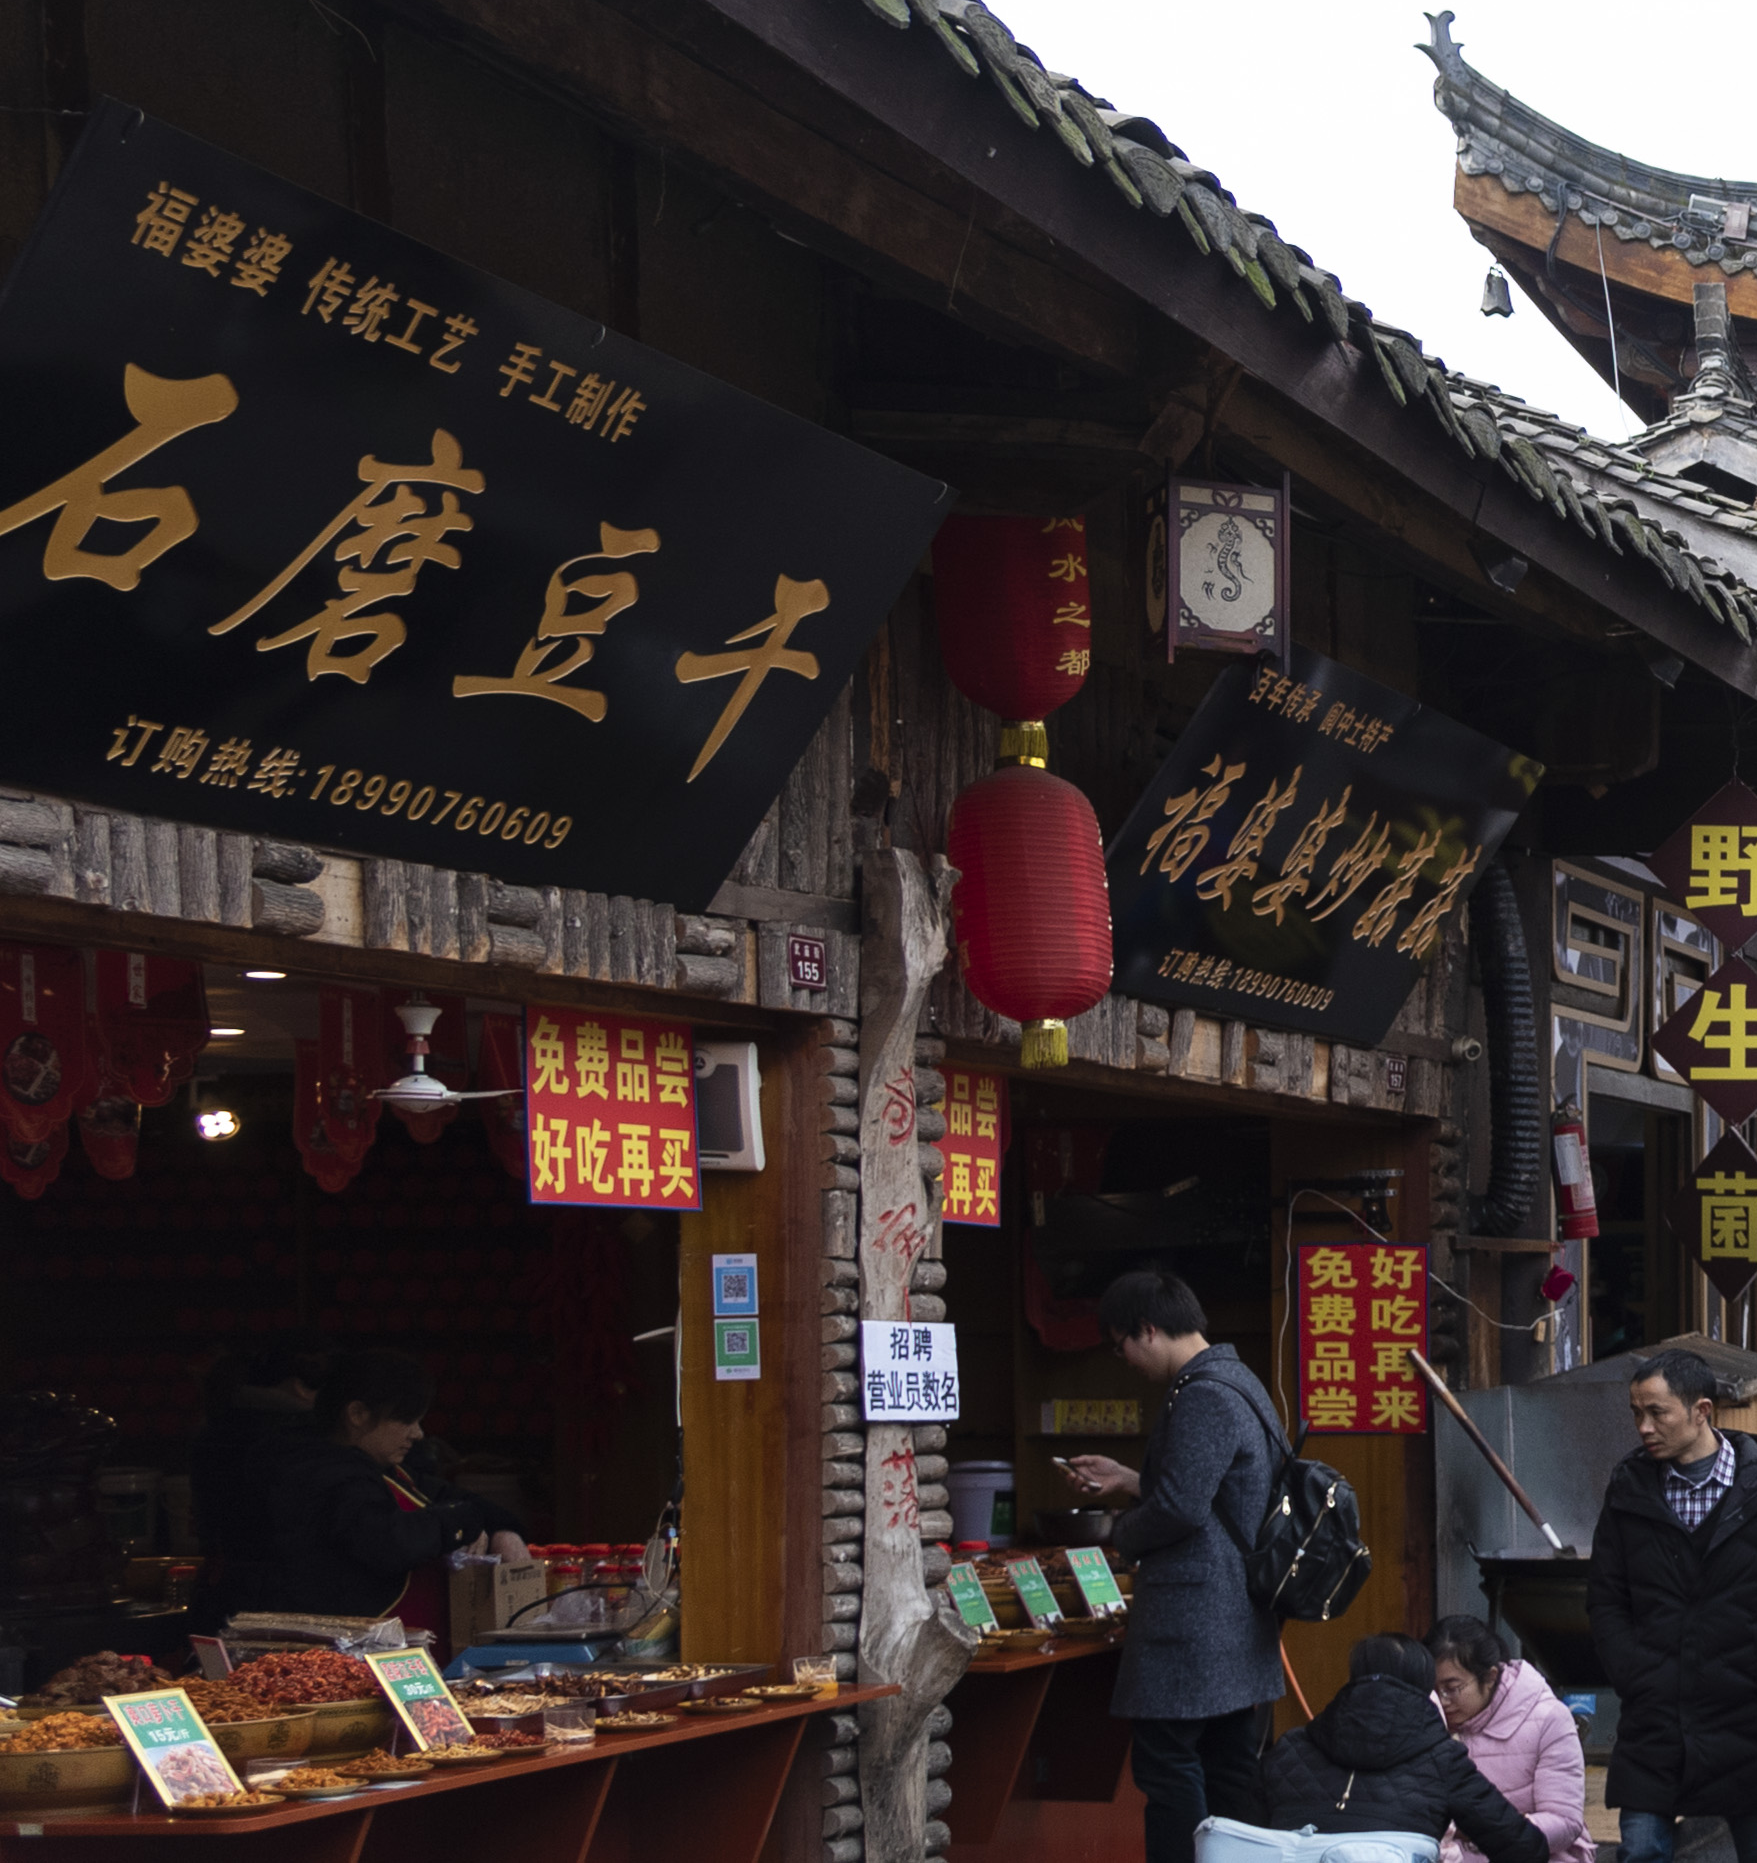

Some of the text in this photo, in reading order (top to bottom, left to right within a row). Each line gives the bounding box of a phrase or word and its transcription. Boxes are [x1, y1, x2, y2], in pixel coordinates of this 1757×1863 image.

[132, 181, 648, 443] 福婆婆 传统工艺 手工制作
[0, 362, 831, 784] 石磨豆干
[1248, 667, 1394, 754] 百年传承 阆中土特产
[797, 960, 819, 982] 155
[531, 1016, 691, 1108] 免费品尝
[934, 1073, 998, 1142] 品尝
[532, 1111, 694, 1199] 好吃再买
[934, 1148, 998, 1218] 再买
[890, 1327, 932, 1361] 招聘
[1307, 1246, 1358, 1429] 免费品尝
[1370, 1247, 1423, 1431] 好吃再来
[867, 1371, 958, 1413] 营业员数名
